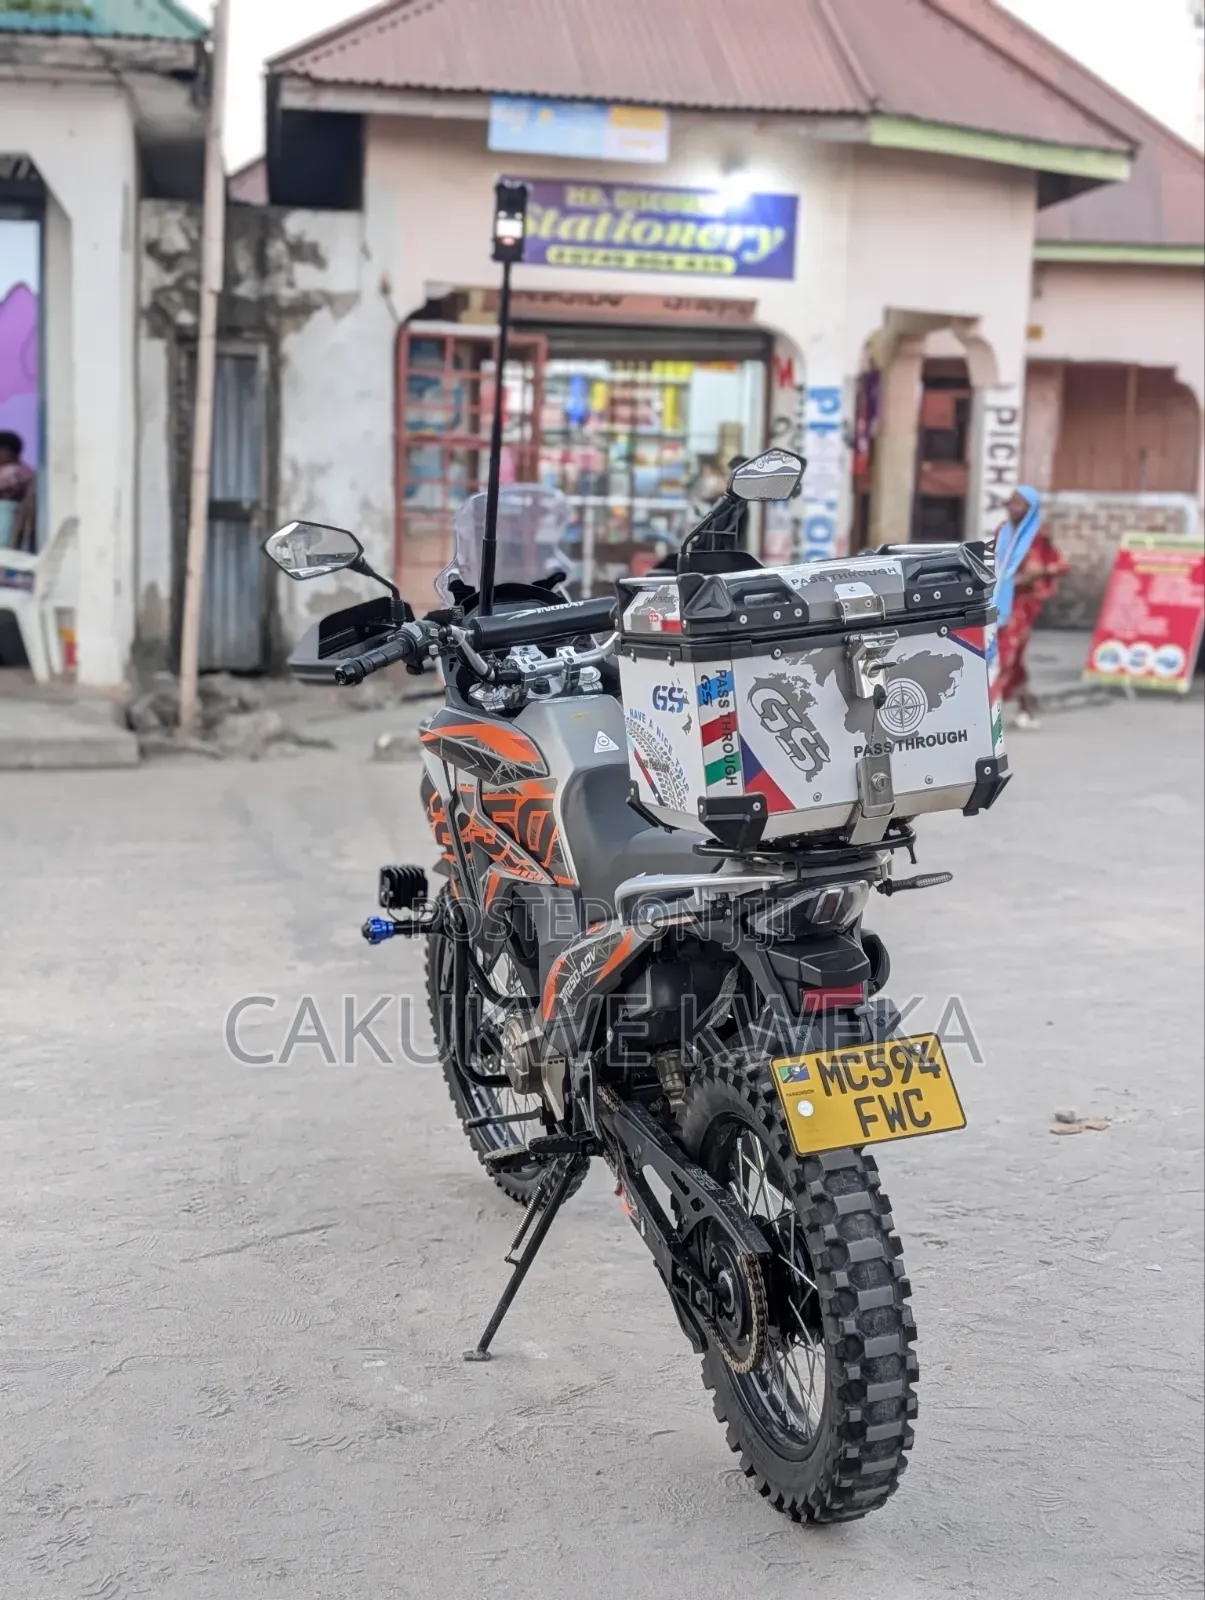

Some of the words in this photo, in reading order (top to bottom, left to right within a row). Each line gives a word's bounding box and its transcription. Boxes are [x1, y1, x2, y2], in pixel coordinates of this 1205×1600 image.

[791, 575, 828, 586] PASS
[829, 567, 897, 580] THROUGH
[652, 685, 684, 713] GS
[701, 675, 713, 707] GS
[716, 670, 730, 709] PASS
[629, 708, 646, 723] HAVE
[648, 719, 654, 731] A
[656, 726, 674, 756] NICE
[675, 757, 690, 793] TRIP
[719, 712, 738, 786] THROUGH
[750, 687, 831, 772] GS
[853, 741, 893, 758] PASS
[895, 729, 968, 752] THROUGH
[816, 1041, 942, 1097] MC594
[854, 1088, 932, 1137] FWC
